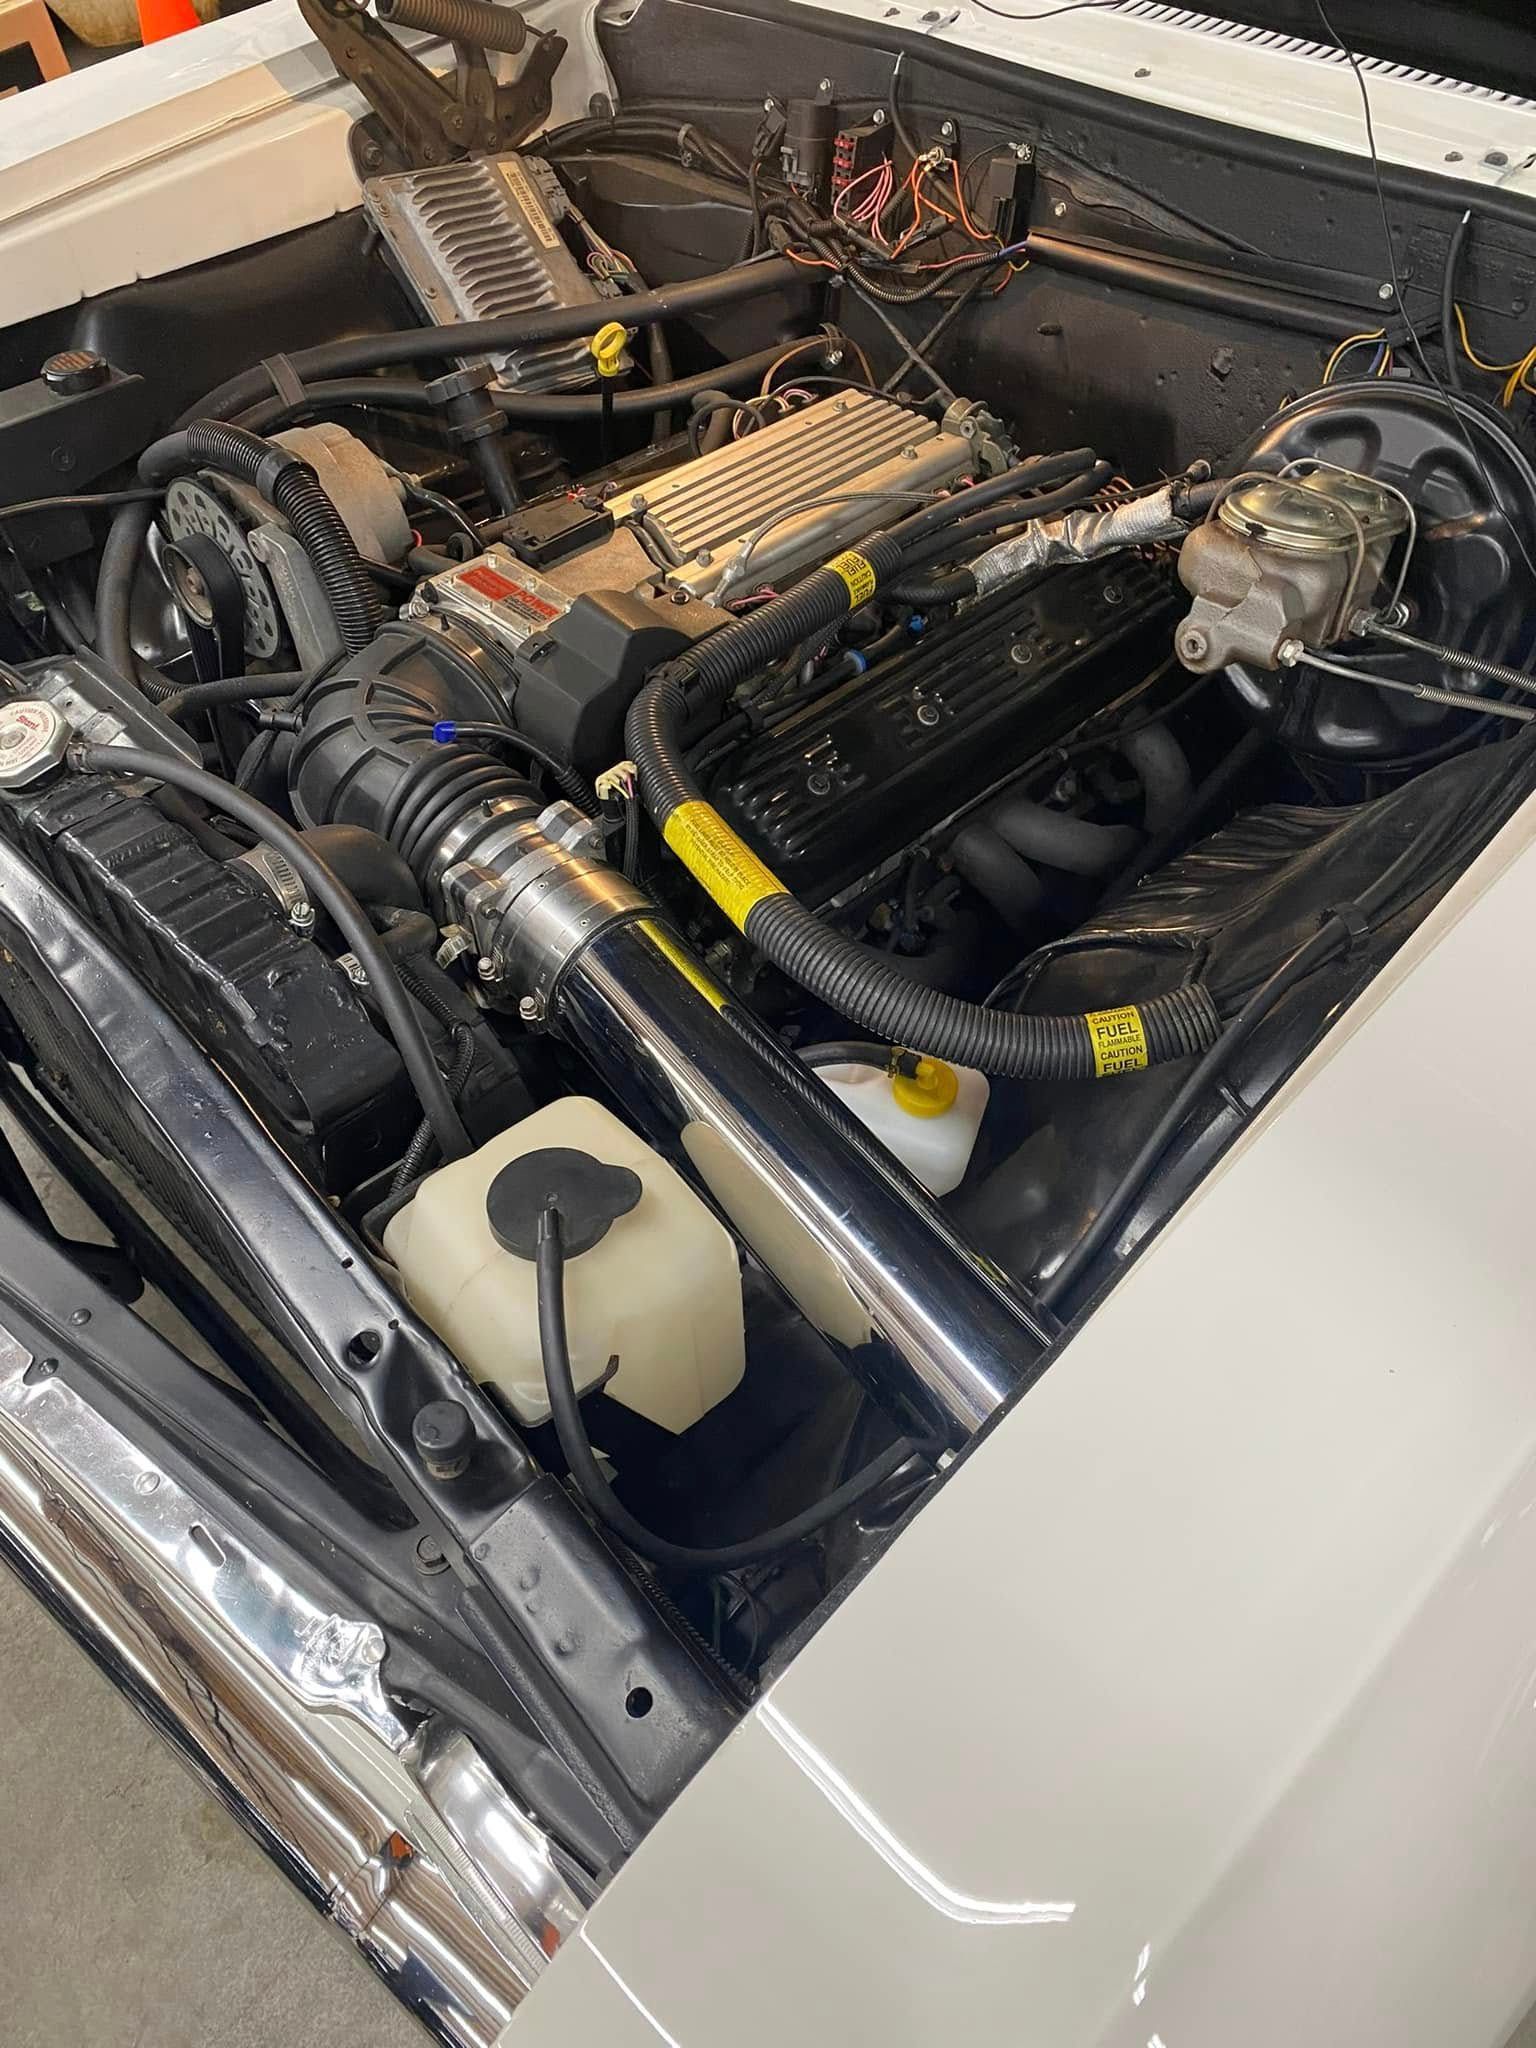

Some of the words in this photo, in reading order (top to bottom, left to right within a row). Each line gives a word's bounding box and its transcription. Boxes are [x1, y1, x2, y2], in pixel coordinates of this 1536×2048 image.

[1092, 1011, 1134, 1025] CAUTION
[1096, 1022, 1138, 1039] FUEL
[1098, 1034, 1141, 1048] FLAMMABLE
[1100, 1045, 1143, 1060] CAUTION
[1103, 1058, 1143, 1072] FUEL
